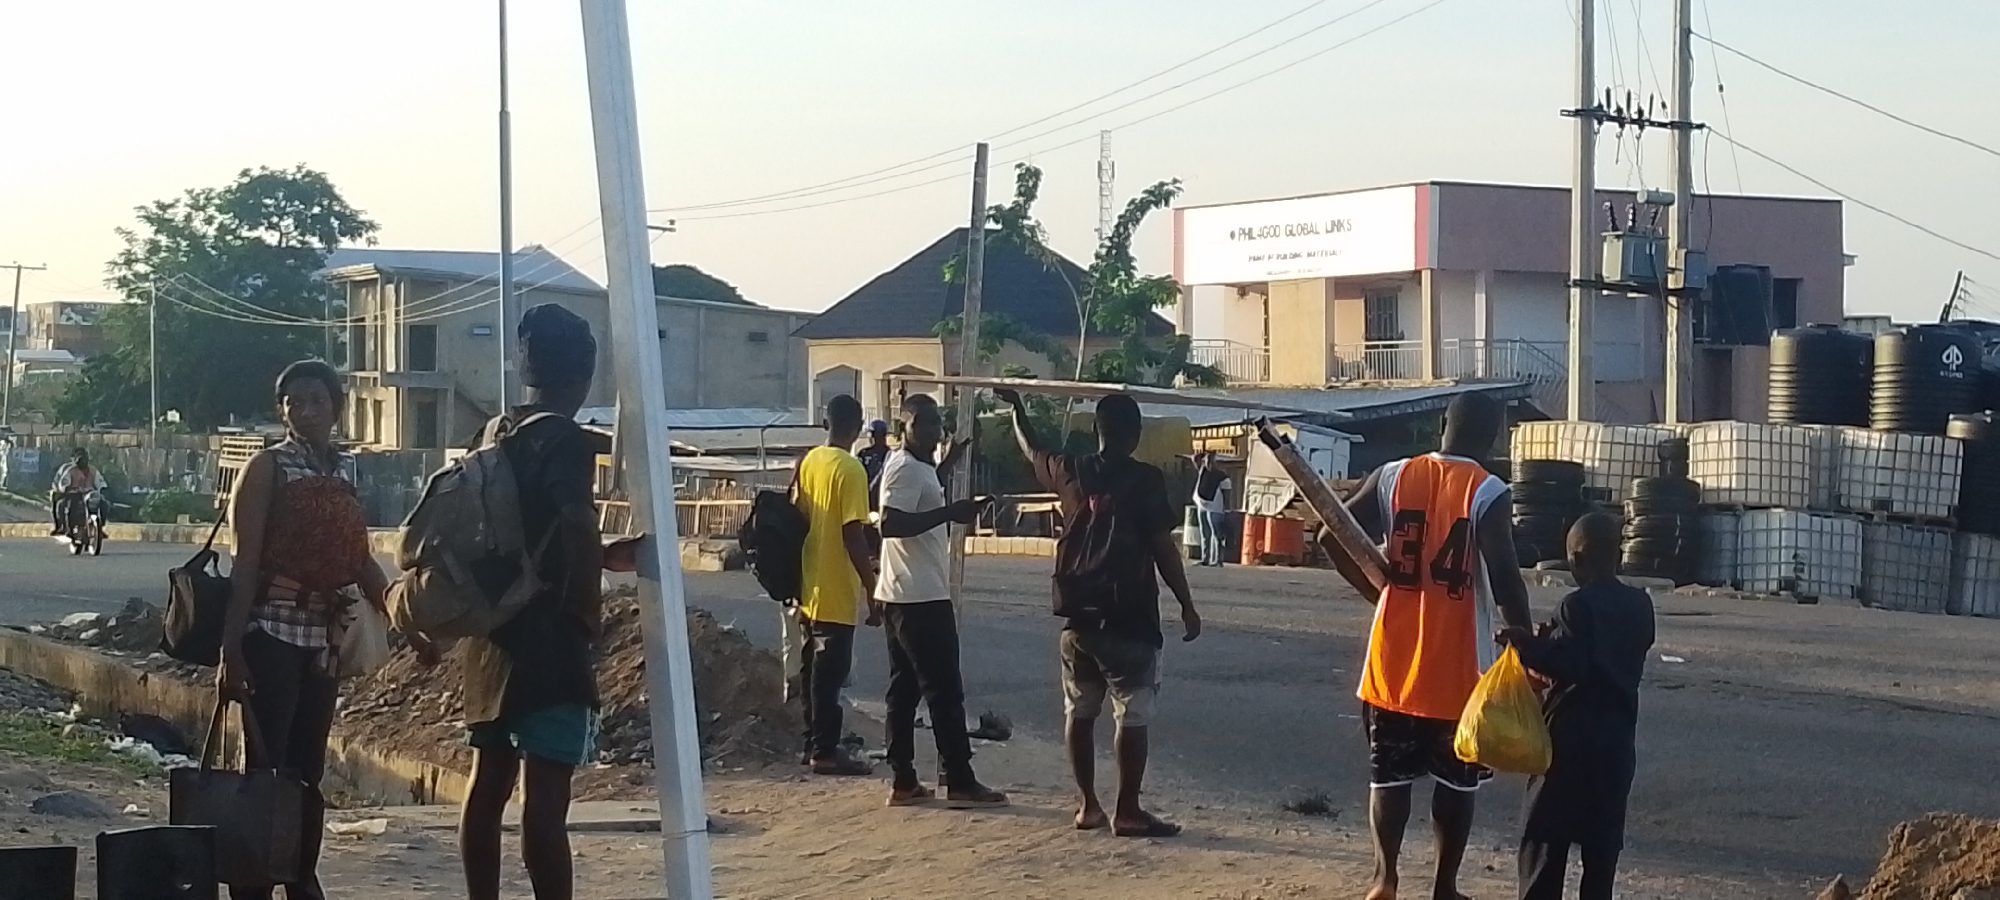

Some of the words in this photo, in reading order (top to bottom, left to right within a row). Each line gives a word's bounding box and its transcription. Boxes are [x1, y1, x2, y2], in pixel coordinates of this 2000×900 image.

[1285, 222, 1320, 237] GLOBAL
[1325, 218, 1352, 234] LINKS
[1390, 509, 1472, 601] 34
